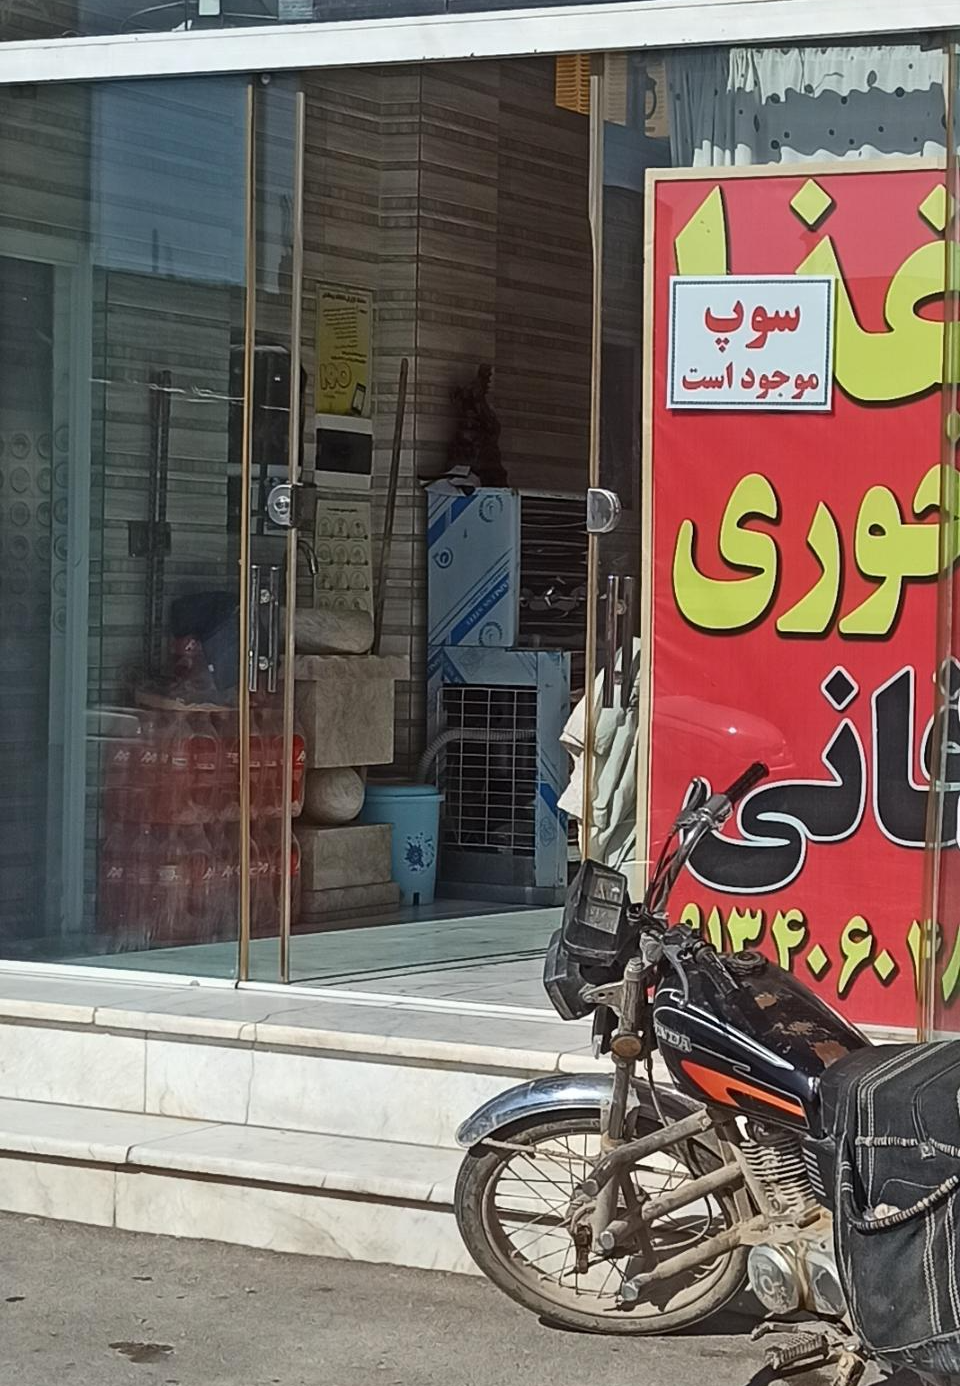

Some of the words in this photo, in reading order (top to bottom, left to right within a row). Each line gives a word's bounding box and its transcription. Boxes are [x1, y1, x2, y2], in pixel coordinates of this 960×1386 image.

[704, 299, 801, 354] سوپ
[681, 361, 734, 391] است
[739, 367, 820, 400] موجود
